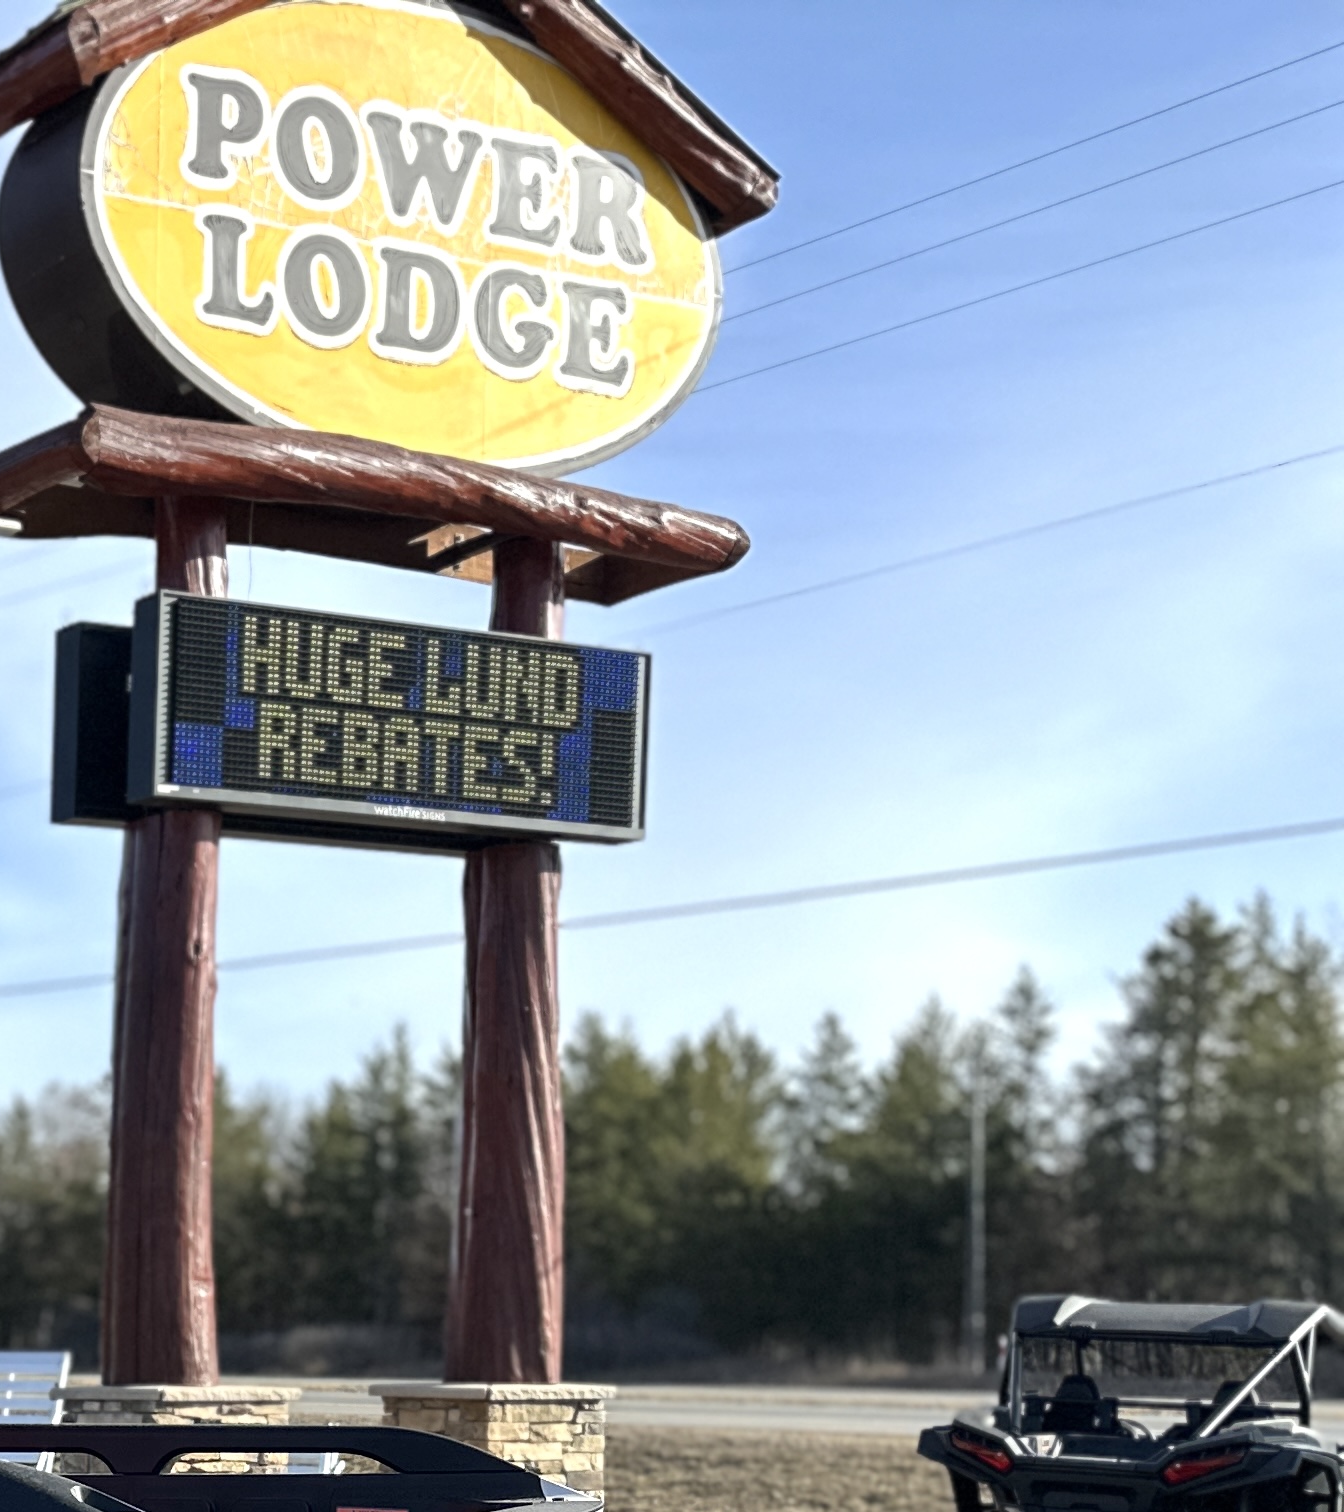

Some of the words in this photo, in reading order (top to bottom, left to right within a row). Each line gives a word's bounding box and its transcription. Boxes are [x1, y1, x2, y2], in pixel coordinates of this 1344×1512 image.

[185, 72, 649, 267] POWER
[201, 213, 631, 387] LODGE
[242, 616, 406, 709] HUGE
[425, 638, 580, 728] LUND
[257, 702, 555, 805] REBATES!
